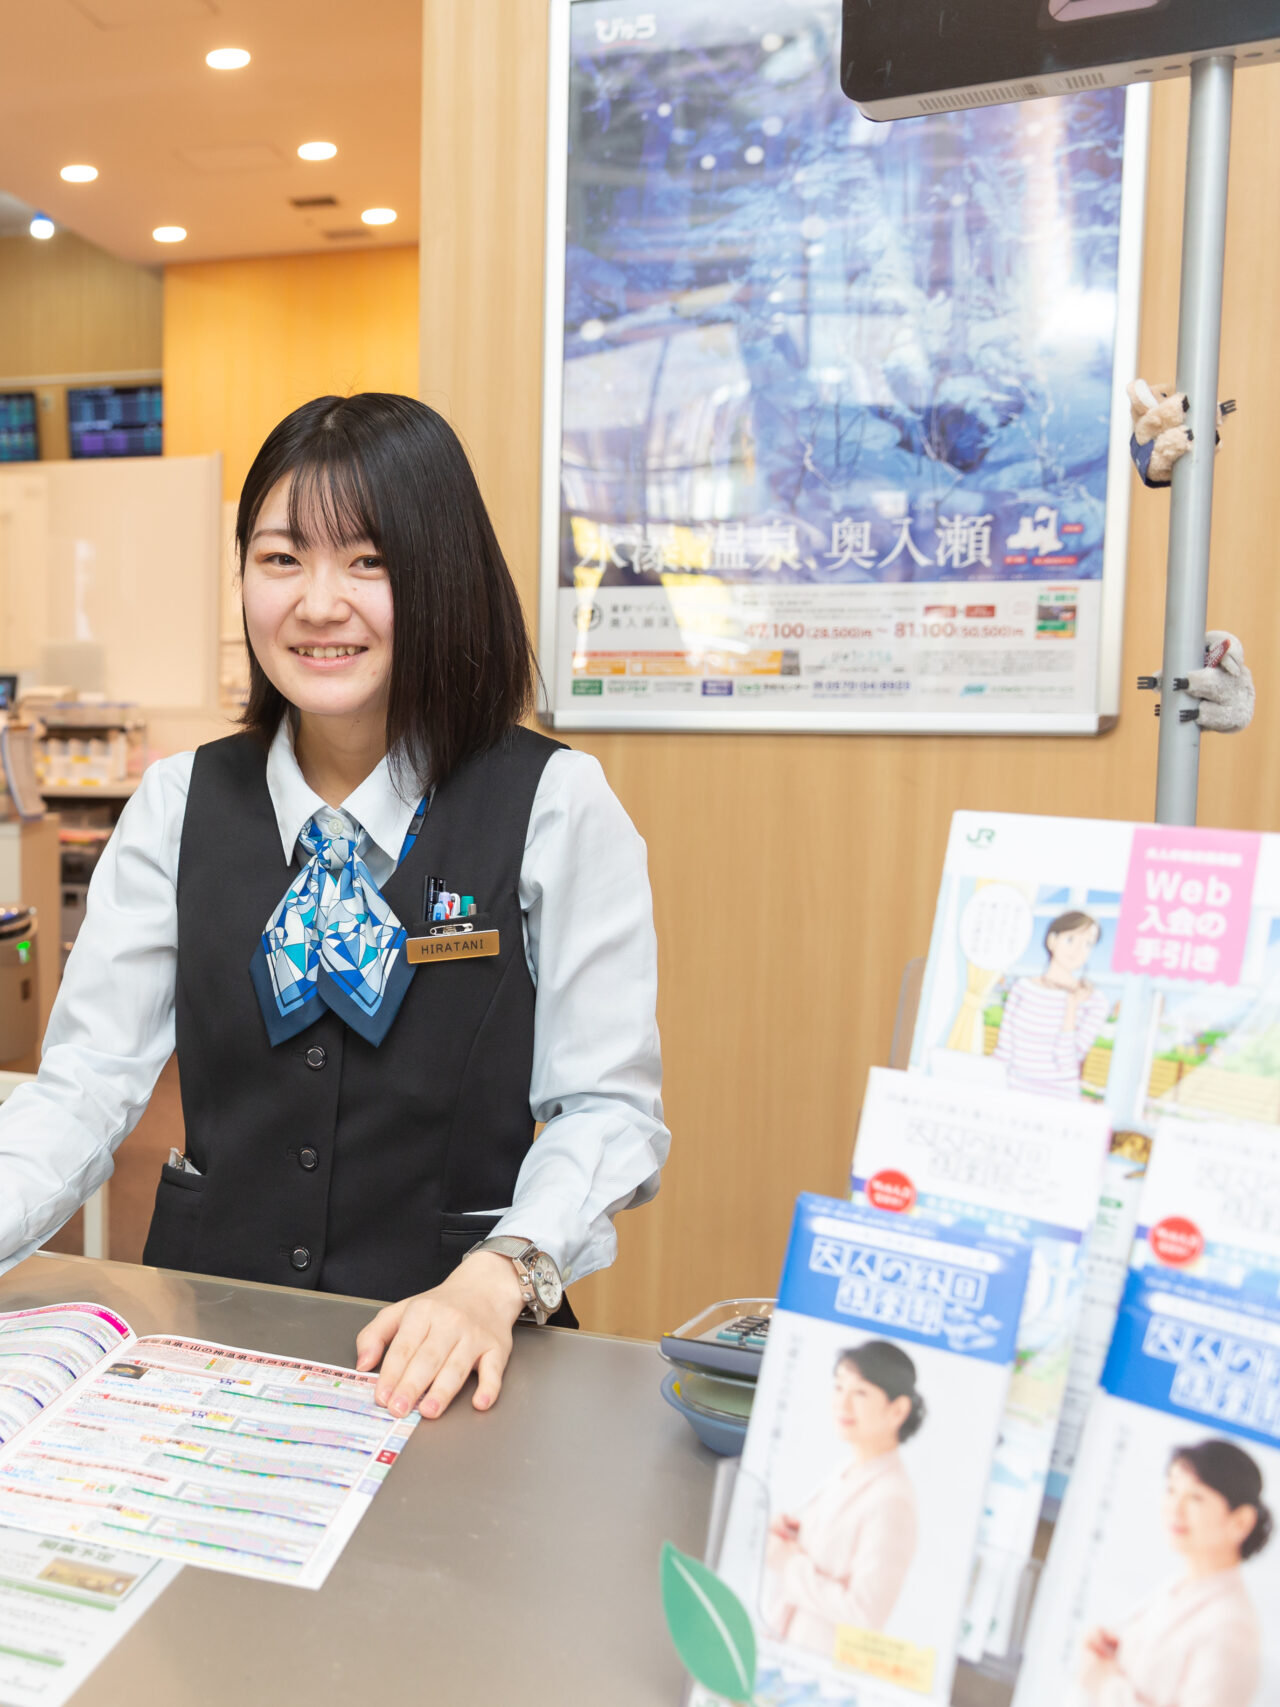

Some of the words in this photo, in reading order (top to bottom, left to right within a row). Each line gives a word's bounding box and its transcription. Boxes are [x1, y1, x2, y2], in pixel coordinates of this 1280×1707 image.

[966, 828, 996, 844] JR
[1145, 869, 1232, 907] Web
[1137, 904, 1227, 939] 入会の
[421, 939, 484, 955] HIRATANI
[1133, 937, 1220, 973] 手引き
